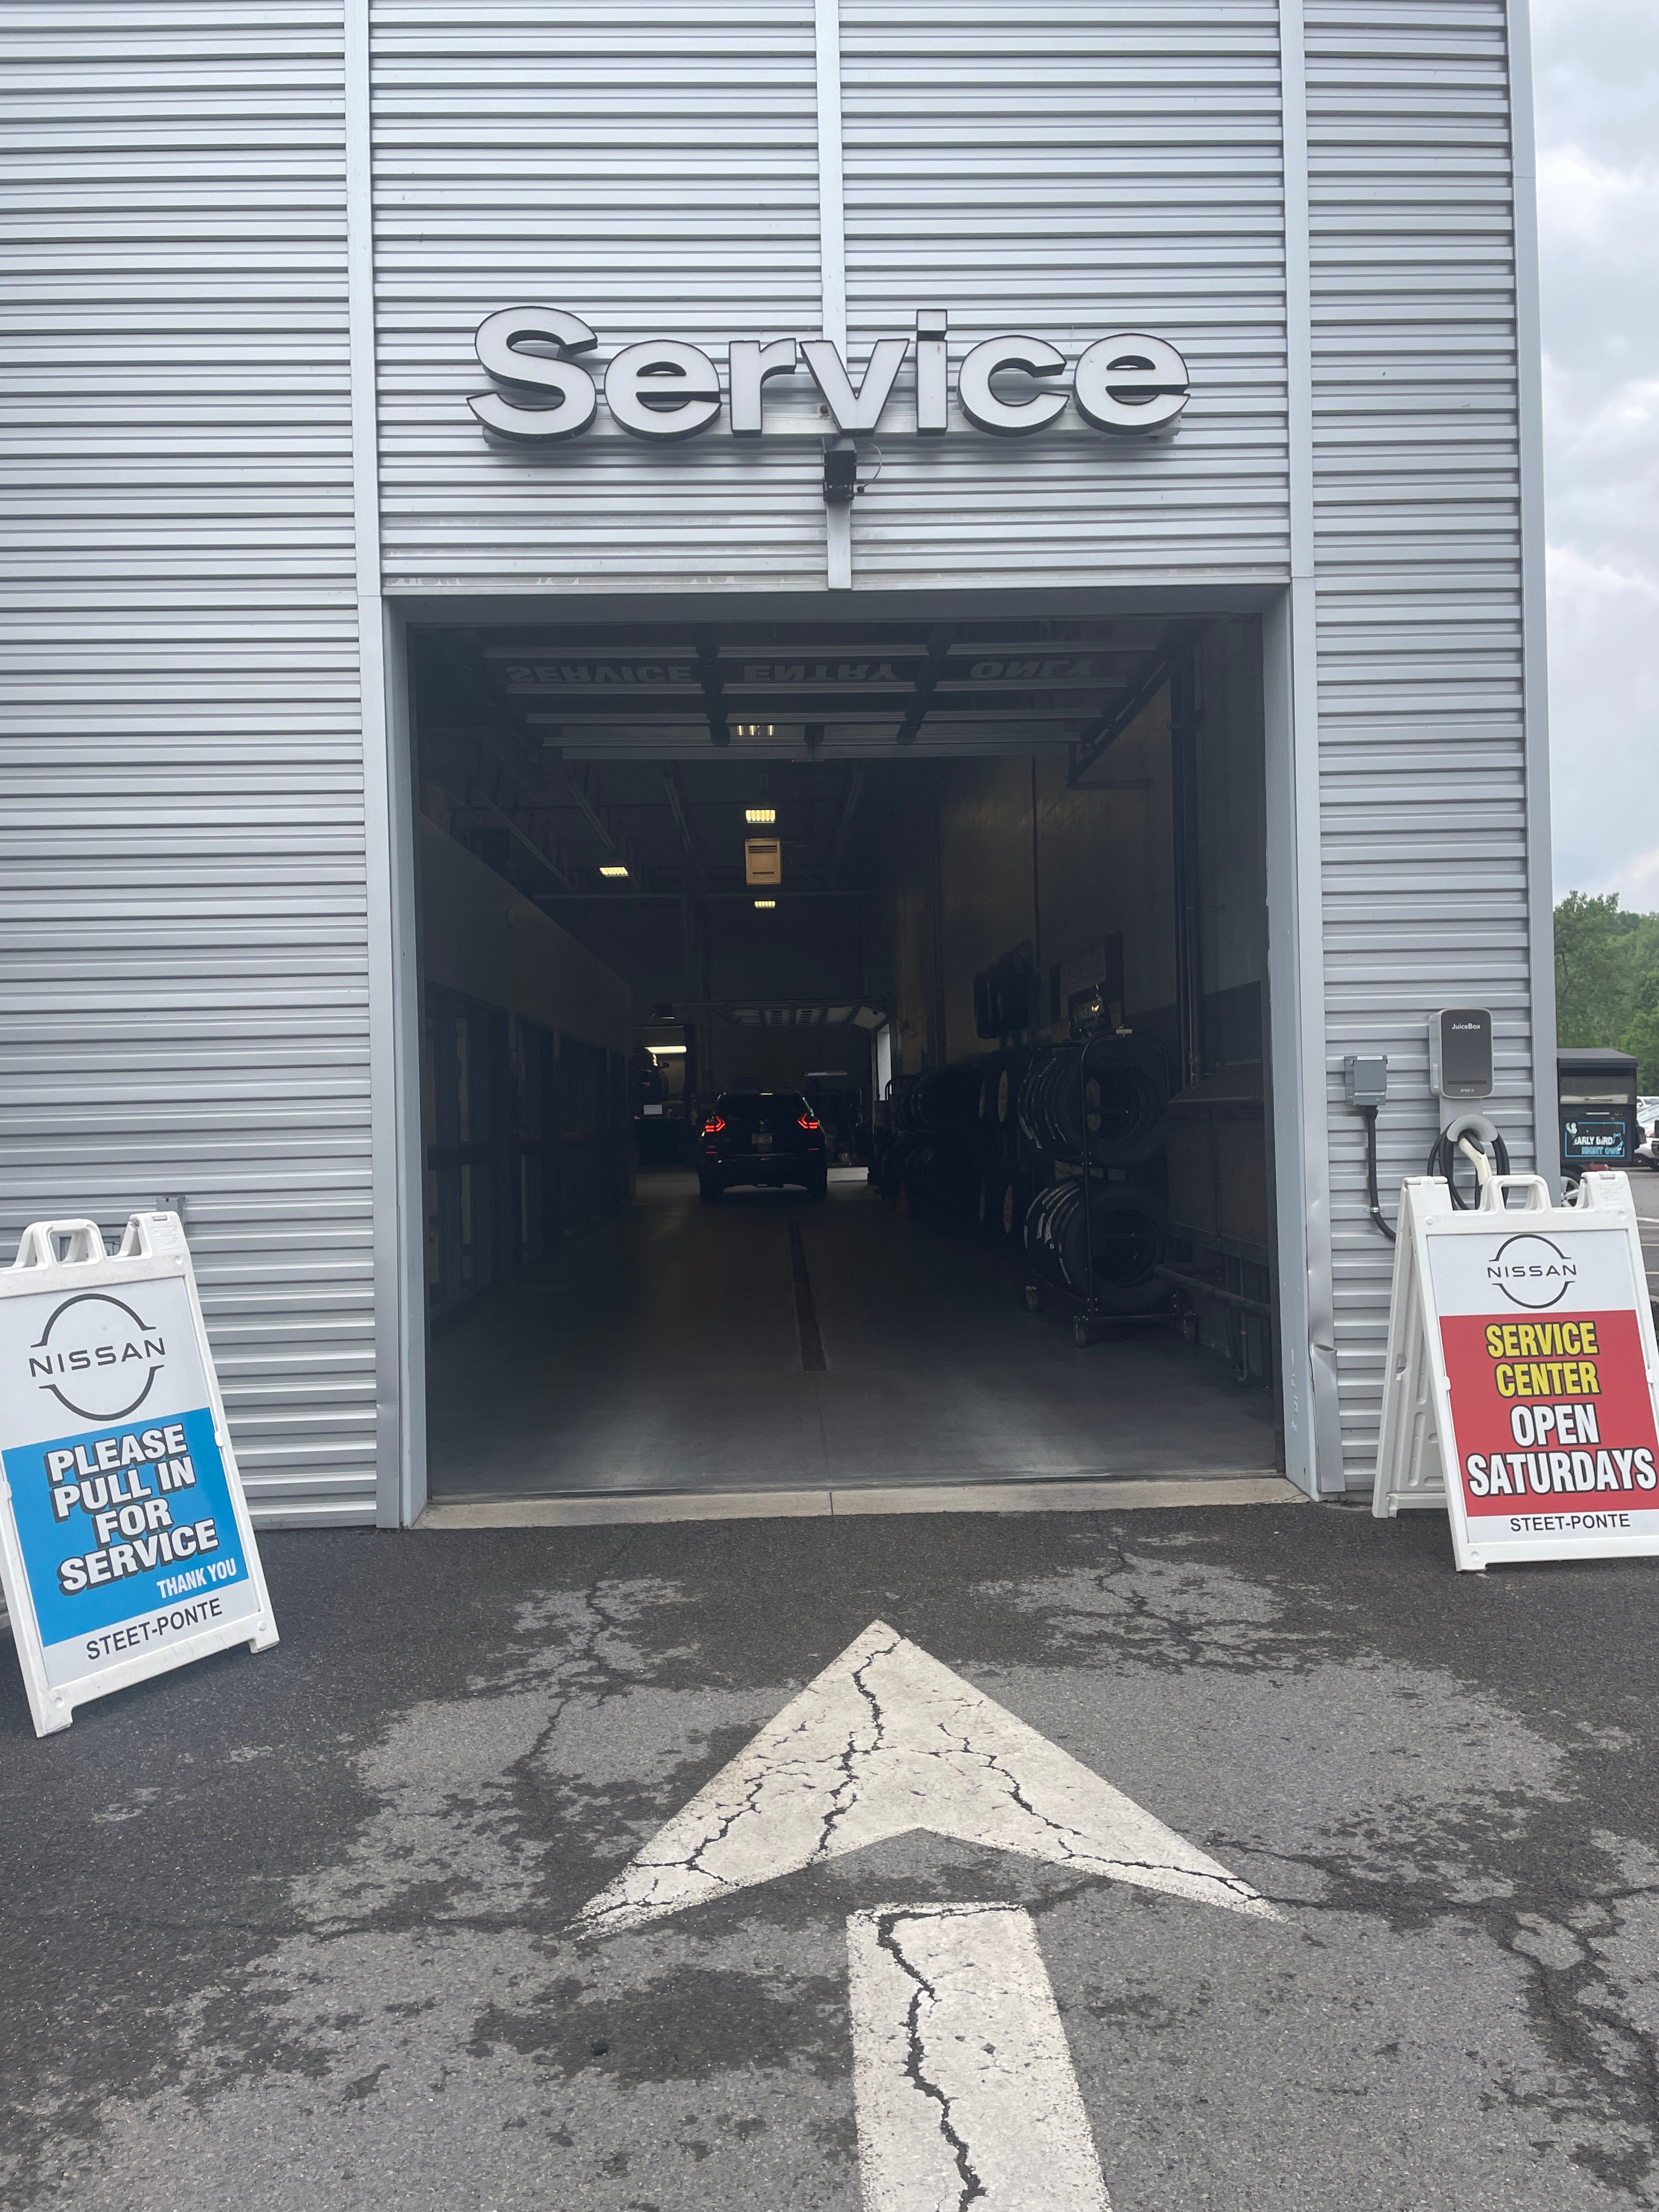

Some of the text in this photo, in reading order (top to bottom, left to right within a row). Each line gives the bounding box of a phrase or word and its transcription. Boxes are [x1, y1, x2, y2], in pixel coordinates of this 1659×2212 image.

[466, 305, 1190, 440] Service
[1596, 1136, 1613, 1146] BIRD
[1487, 1262, 1577, 1279] NISSAN
[29, 1337, 166, 1378] NISSAN
[1485, 1321, 1600, 1359] SERVICE
[1494, 1359, 1601, 1398] CENTER
[1510, 1403, 1599, 1449] OPEN
[45, 1423, 187, 1485] PLEASE
[1465, 1447, 1656, 1498] SATURDAYS
[53, 1455, 198, 1522] PULL IN
[92, 1497, 173, 1547] FOR
[1510, 1513, 1631, 1532] STEET-PONTE
[58, 1518, 219, 1596] SERVICE
[156, 1557, 237, 1599] THANK YOU
[87, 1598, 223, 1660] STEET-PONTE
